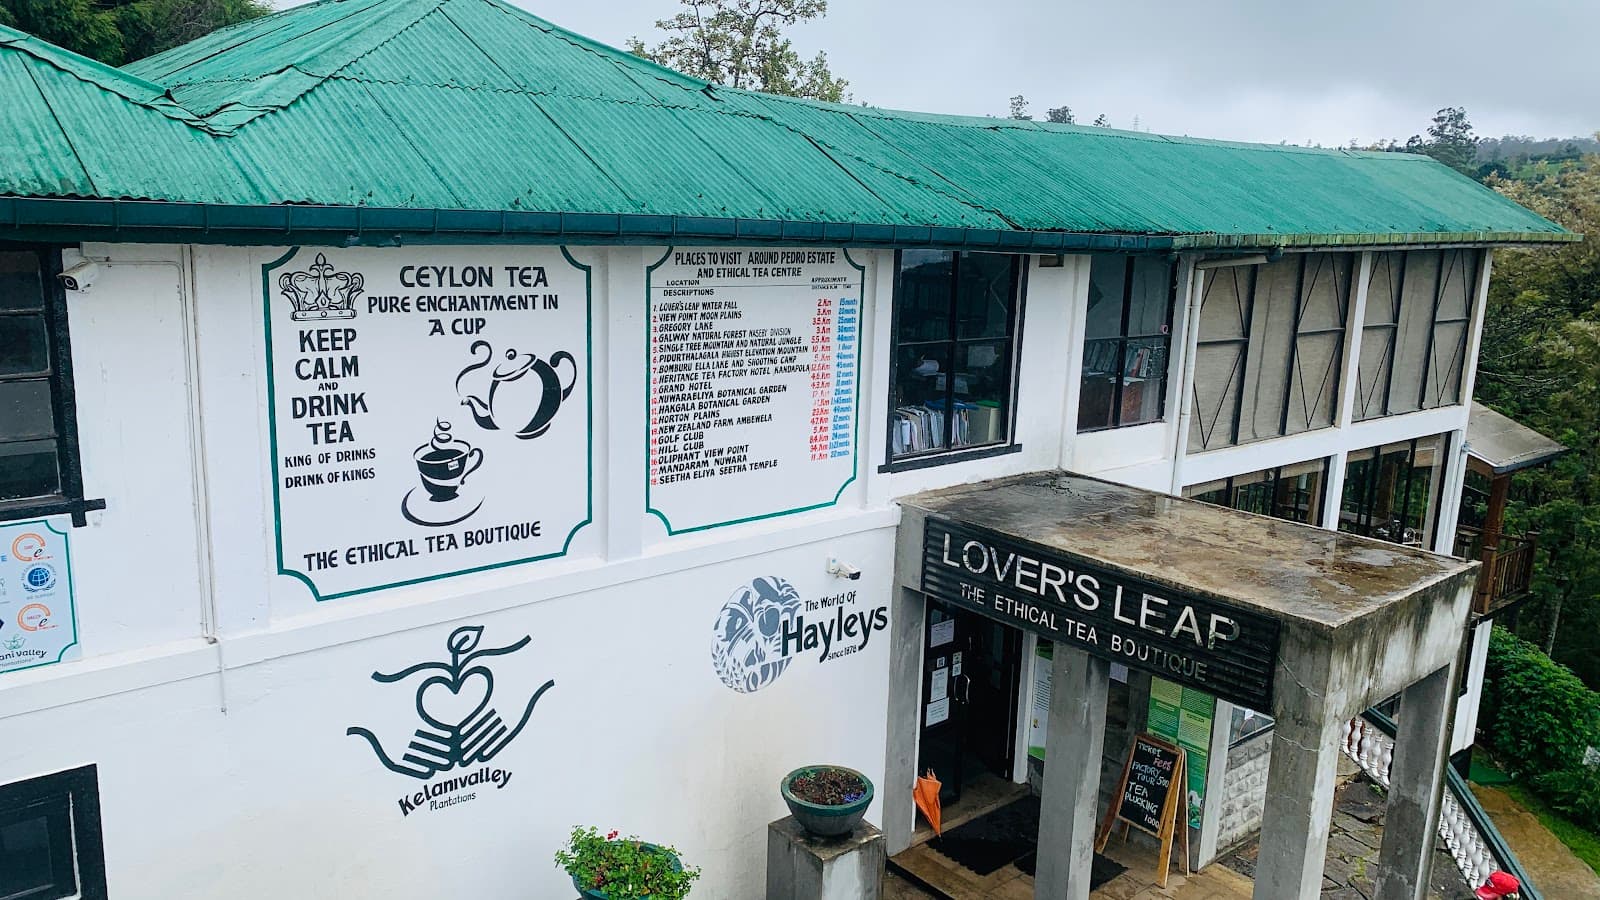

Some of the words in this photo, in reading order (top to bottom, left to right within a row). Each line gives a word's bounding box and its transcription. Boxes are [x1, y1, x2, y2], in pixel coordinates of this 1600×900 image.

[674, 252, 706, 265] PLACES
[707, 252, 719, 265] TO
[720, 252, 742, 265] VISIT
[748, 251, 779, 265] AROUND
[780, 251, 806, 264] PEDRO
[807, 251, 836, 264] ESTATE
[400, 265, 494, 288] CEYLON
[504, 265, 549, 288] TEA
[697, 267, 714, 279] AND
[716, 267, 751, 278] ETHICAL
[752, 267, 769, 277] TEA
[771, 267, 802, 277] CENTRE
[663, 289, 715, 297] DESCRIPTIONS
[367, 295, 411, 314] PURE
[416, 294, 541, 312] ENCHANTMENT
[543, 294, 559, 310] IN
[702, 301, 723, 310] WATER
[724, 301, 738, 310] FALL
[428, 318, 446, 336] A
[451, 317, 487, 336] CUP
[659, 312, 677, 322] VIEW
[678, 312, 698, 321] POINT
[700, 311, 719, 320] MOON
[720, 311, 742, 320] PLAINS
[659, 322, 692, 332] GREGORY
[694, 322, 713, 331] LAKE
[659, 332, 690, 342] GALWAY
[692, 331, 722, 341] NATURAL
[723, 330, 747, 339] FOREST
[299, 328, 357, 352] KEEP
[659, 343, 684, 353] SINGLE
[686, 342, 702, 352] TREE
[702, 340, 735, 350] MOUNTAIN
[736, 339, 748, 348] AND
[750, 338, 777, 348] NATURAL
[778, 336, 802, 346] JUNGLE
[295, 355, 360, 381] CALM
[695, 362, 711, 371] ELLA
[712, 360, 729, 370] LAKE
[732, 359, 744, 368] AND
[780, 356, 797, 364] CAMP
[659, 372, 699, 384] HERITANCE
[702, 371, 716, 380] TEA
[718, 368, 748, 379] FACTORY
[750, 366, 771, 376] HOTEL
[318, 381, 339, 391] AND
[659, 384, 685, 394] GRAND
[688, 382, 712, 391] HOTEL
[659, 390, 714, 404] NUWARAELIYA
[717, 387, 757, 398] BOTANICAL
[760, 384, 788, 394] GARDEN
[291, 392, 369, 420] DRINK
[659, 402, 696, 414] HAKGALA
[698, 398, 740, 410] BOTANICAL
[742, 395, 771, 406] GARDEN
[659, 413, 690, 424] HORTON
[694, 410, 721, 420] PLAINS
[659, 424, 676, 434] NEW
[677, 420, 711, 432] ZEALAND
[713, 418, 734, 428] FARM
[736, 414, 773, 426] AMBEWELA
[306, 420, 355, 446] TEA
[658, 434, 680, 445] GOLF
[683, 431, 704, 442] CLUB
[284, 453, 312, 469] KING
[318, 451, 332, 465] OF
[336, 447, 377, 463] DRINKS
[659, 444, 678, 455] HILL
[683, 441, 704, 451] CLUB
[659, 451, 701, 465] OLIPHANT
[704, 448, 724, 458] VIEW
[727, 444, 750, 455] POINT
[659, 460, 710, 475] MANDARAM
[714, 454, 748, 466] NUWARA
[660, 472, 691, 485] SEETHA
[693, 468, 716, 480] ELIYA
[719, 464, 748, 476] SEETHA
[749, 460, 778, 471] TEMPLE
[285, 473, 325, 489] DRINK
[327, 471, 341, 483] OF
[342, 467, 376, 483] KINGS
[304, 549, 339, 572] THE
[345, 538, 420, 566] ETHICAL
[425, 532, 459, 554] TEA
[464, 520, 542, 548] BOUTIQUE
[805, 600, 819, 612] The
[820, 593, 844, 608] World
[847, 590, 857, 604] Of
[942, 533, 1101, 612] LOVER'S
[1112, 585, 1241, 651] LEAP
[782, 606, 888, 663] Hayleys
[959, 582, 985, 605] THE
[994, 597, 1059, 632] ETHICAL
[1066, 618, 1098, 645] TEA
[1111, 634, 1208, 682] BOUTIQUE
[398, 767, 513, 817] Kelanivalley
[1128, 781, 1149, 798] TEA
[430, 792, 477, 812] Plantations
[1124, 791, 1159, 816] PLUCKING
